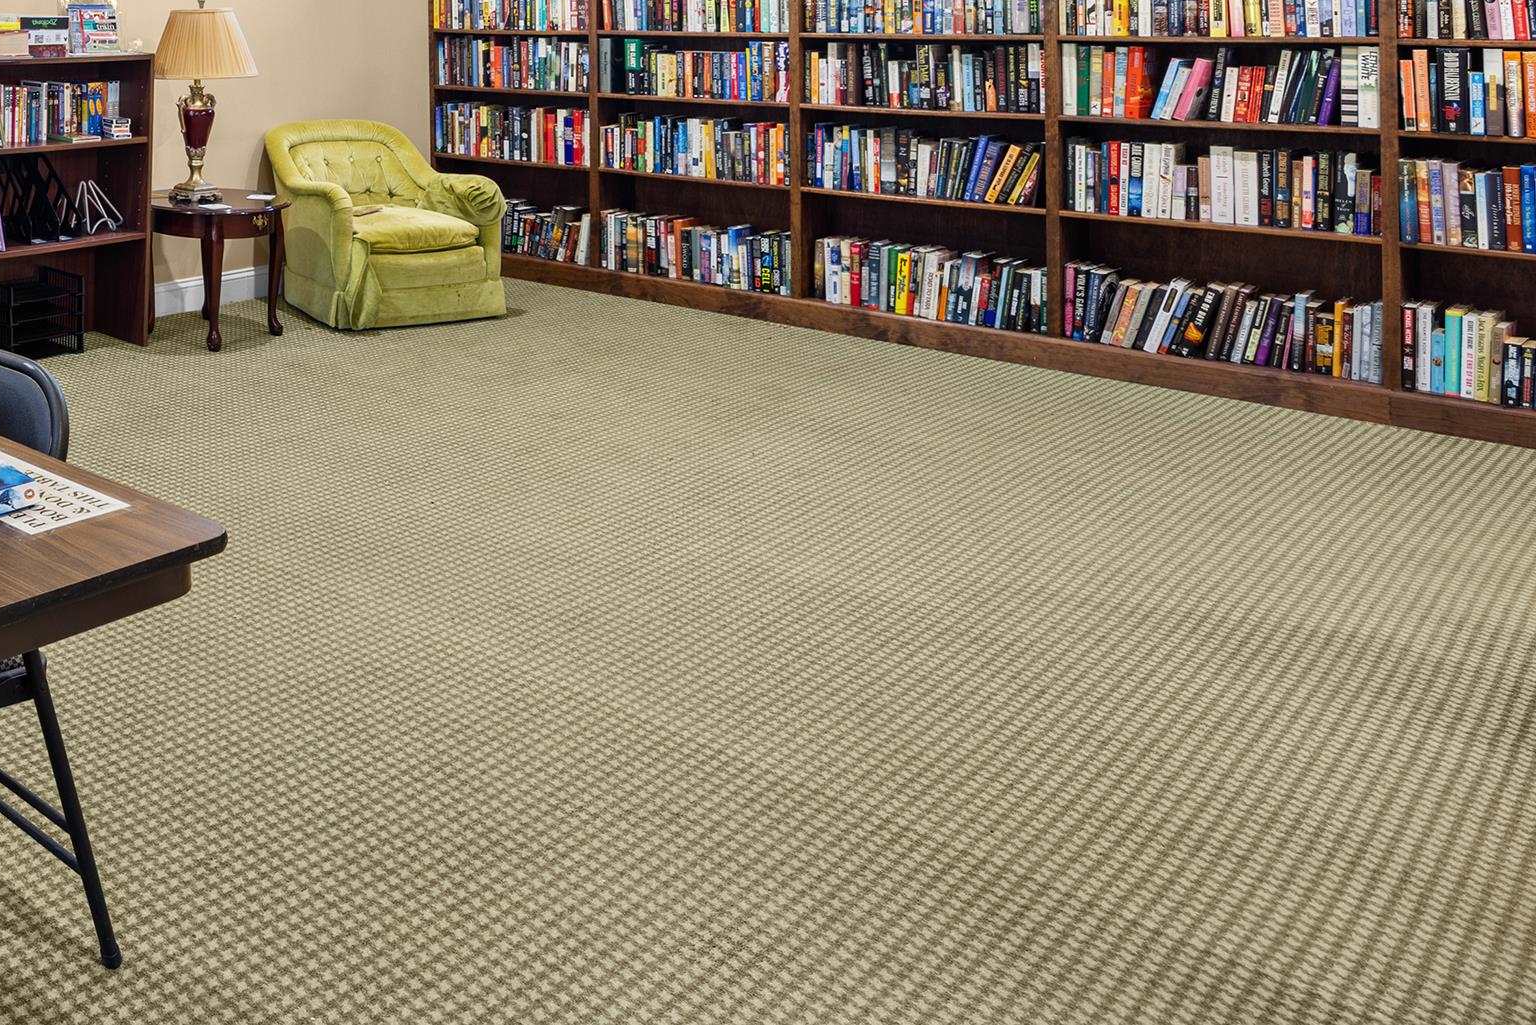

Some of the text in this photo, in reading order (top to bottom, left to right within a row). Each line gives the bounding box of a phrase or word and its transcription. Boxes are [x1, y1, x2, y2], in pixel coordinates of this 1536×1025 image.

[1361, 55, 1370, 80] WHITE
[1369, 51, 1378, 78] LETHAL
[1131, 157, 1141, 177] GARWOOD
[762, 268, 770, 285] CELL
[924, 296, 932, 310] TARA
[1075, 274, 1086, 316] VOLK'S GAME
[1195, 291, 1215, 326] END OF DAYS
[73, 491, 109, 508] THIS
